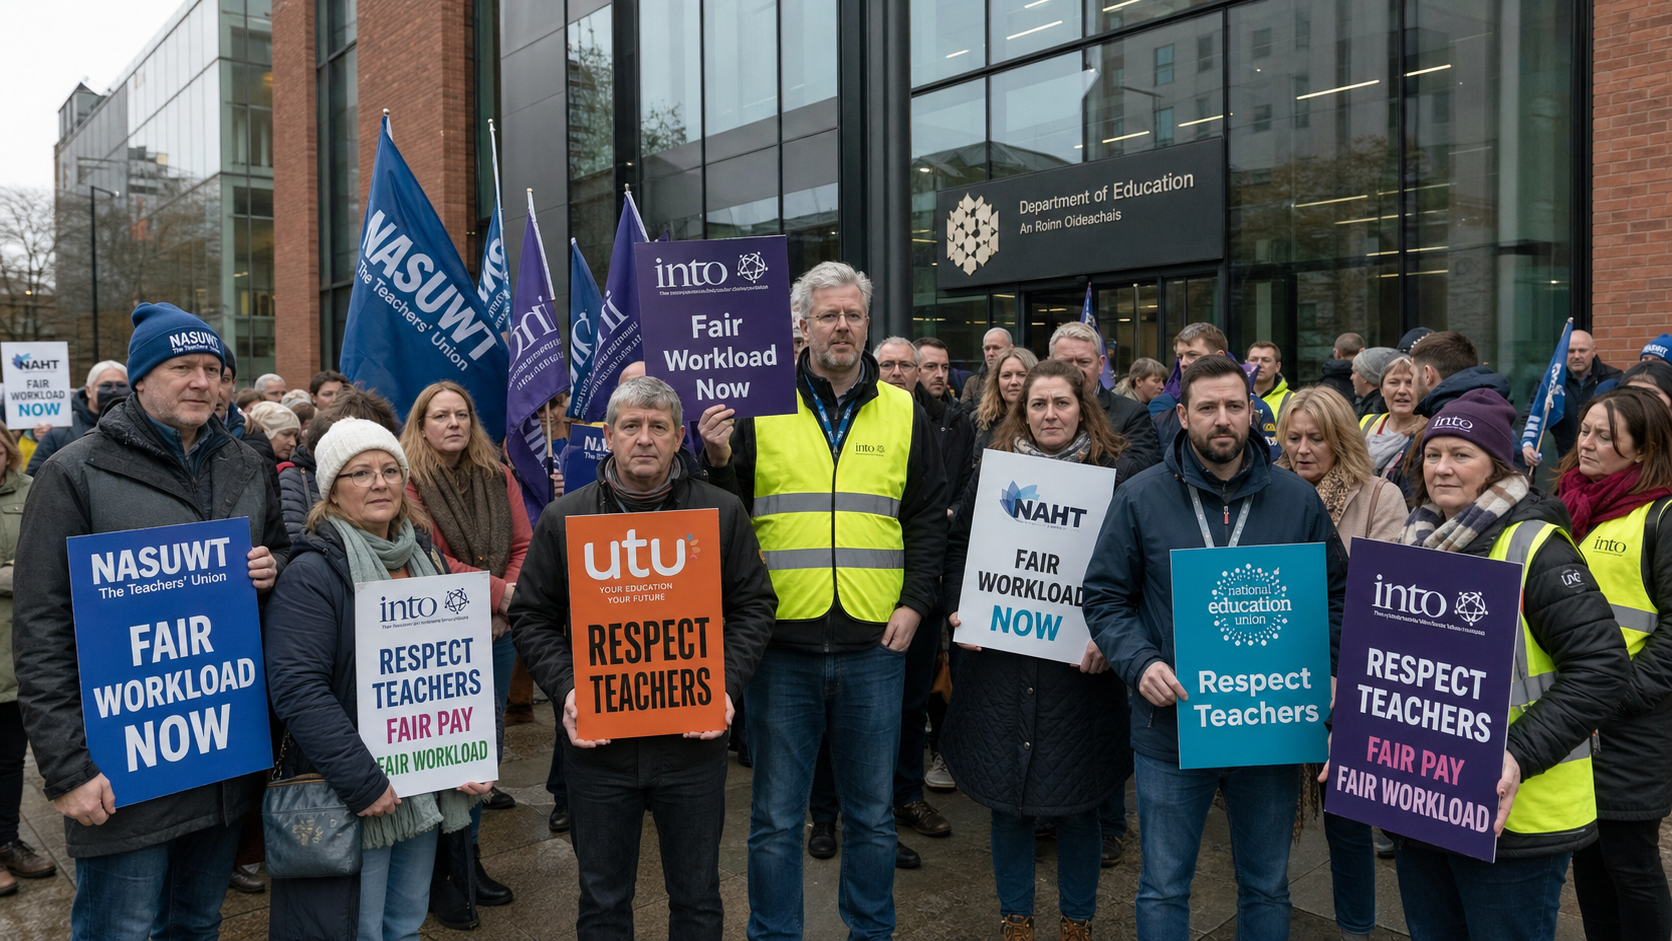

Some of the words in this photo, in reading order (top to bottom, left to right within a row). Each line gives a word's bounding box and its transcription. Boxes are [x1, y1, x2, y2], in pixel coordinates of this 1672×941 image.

[1019, 189, 1090, 215] Department
[1093, 185, 1108, 202] of
[1113, 172, 1194, 200] Education
[1019, 222, 1033, 235] An
[1035, 217, 1062, 232] Roinn
[1064, 209, 1122, 229] Oideachais
[362, 209, 497, 361] NASUWT
[654, 257, 728, 289] into
[357, 260, 373, 285] The
[372, 277, 434, 334] Teachers'
[431, 327, 468, 372] Union
[691, 312, 743, 339] Fair
[169, 331, 219, 349] NASUWT
[20, 360, 60, 370] NAHT
[664, 344, 777, 372] Workload
[10, 391, 65, 401] WORKLOAD
[26, 379, 50, 389] FAIR
[696, 379, 750, 401] Now
[18, 403, 61, 417] NOW
[1434, 416, 1473, 429] into
[856, 443, 875, 453] into
[1013, 498, 1087, 528] NAHT
[584, 529, 686, 581] utu
[1594, 536, 1627, 553] into
[91, 537, 230, 585] NASUWT
[1015, 548, 1060, 575] FAIR
[98, 586, 125, 599] The
[127, 576, 188, 595] Teachers'
[191, 571, 227, 585] Union
[599, 585, 623, 594] YOUR
[625, 582, 673, 592] EDUCATION
[607, 595, 631, 604] YOUR
[633, 593, 665, 602] FUTURE
[978, 570, 1083, 607] WORKLOAD
[1228, 584, 1272, 596] national
[1371, 573, 1447, 618] into
[380, 596, 438, 623] into
[1208, 597, 1292, 614] education
[1235, 615, 1266, 626] union
[990, 605, 1063, 642] NOW
[129, 614, 214, 667] FAIR
[588, 617, 710, 667] RESPECT
[379, 637, 474, 675] RESPECT
[93, 657, 256, 719] WORKLOAD
[1198, 667, 1312, 697] Respect
[1366, 647, 1487, 700] RESPECT
[372, 668, 482, 710] TEACHERS
[589, 667, 712, 714] TEACHERS
[386, 712, 432, 745] FAIR
[437, 706, 474, 737] PAY
[1193, 701, 1319, 728] Teachers
[1357, 684, 1492, 743] TEACHERS
[124, 703, 231, 773] NOW
[376, 752, 410, 777] FAIR
[412, 740, 488, 772] WORKLOAD
[1366, 735, 1416, 774] FAIR
[1420, 749, 1465, 786] PAY
[1336, 765, 1378, 801] FAIR
[1382, 777, 1490, 834] WORKLOAD
